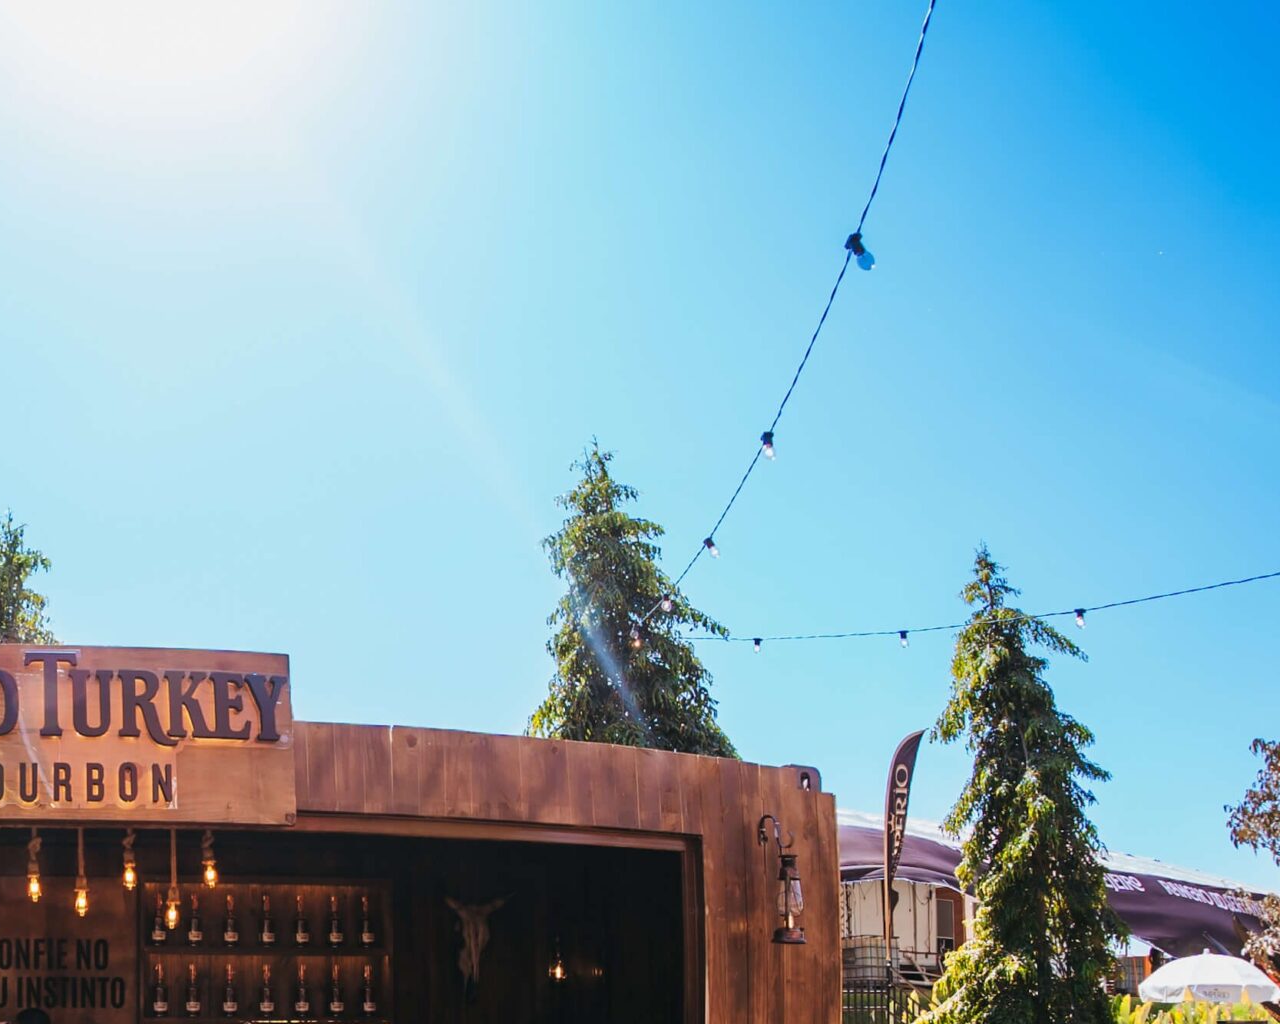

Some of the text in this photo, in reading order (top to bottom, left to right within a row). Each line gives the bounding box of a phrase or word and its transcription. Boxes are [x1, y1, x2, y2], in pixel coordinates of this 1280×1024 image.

[23, 651, 289, 747] TURKEY
[76, 938, 109, 970] NO
[17, 976, 126, 1009] INSTINTO
